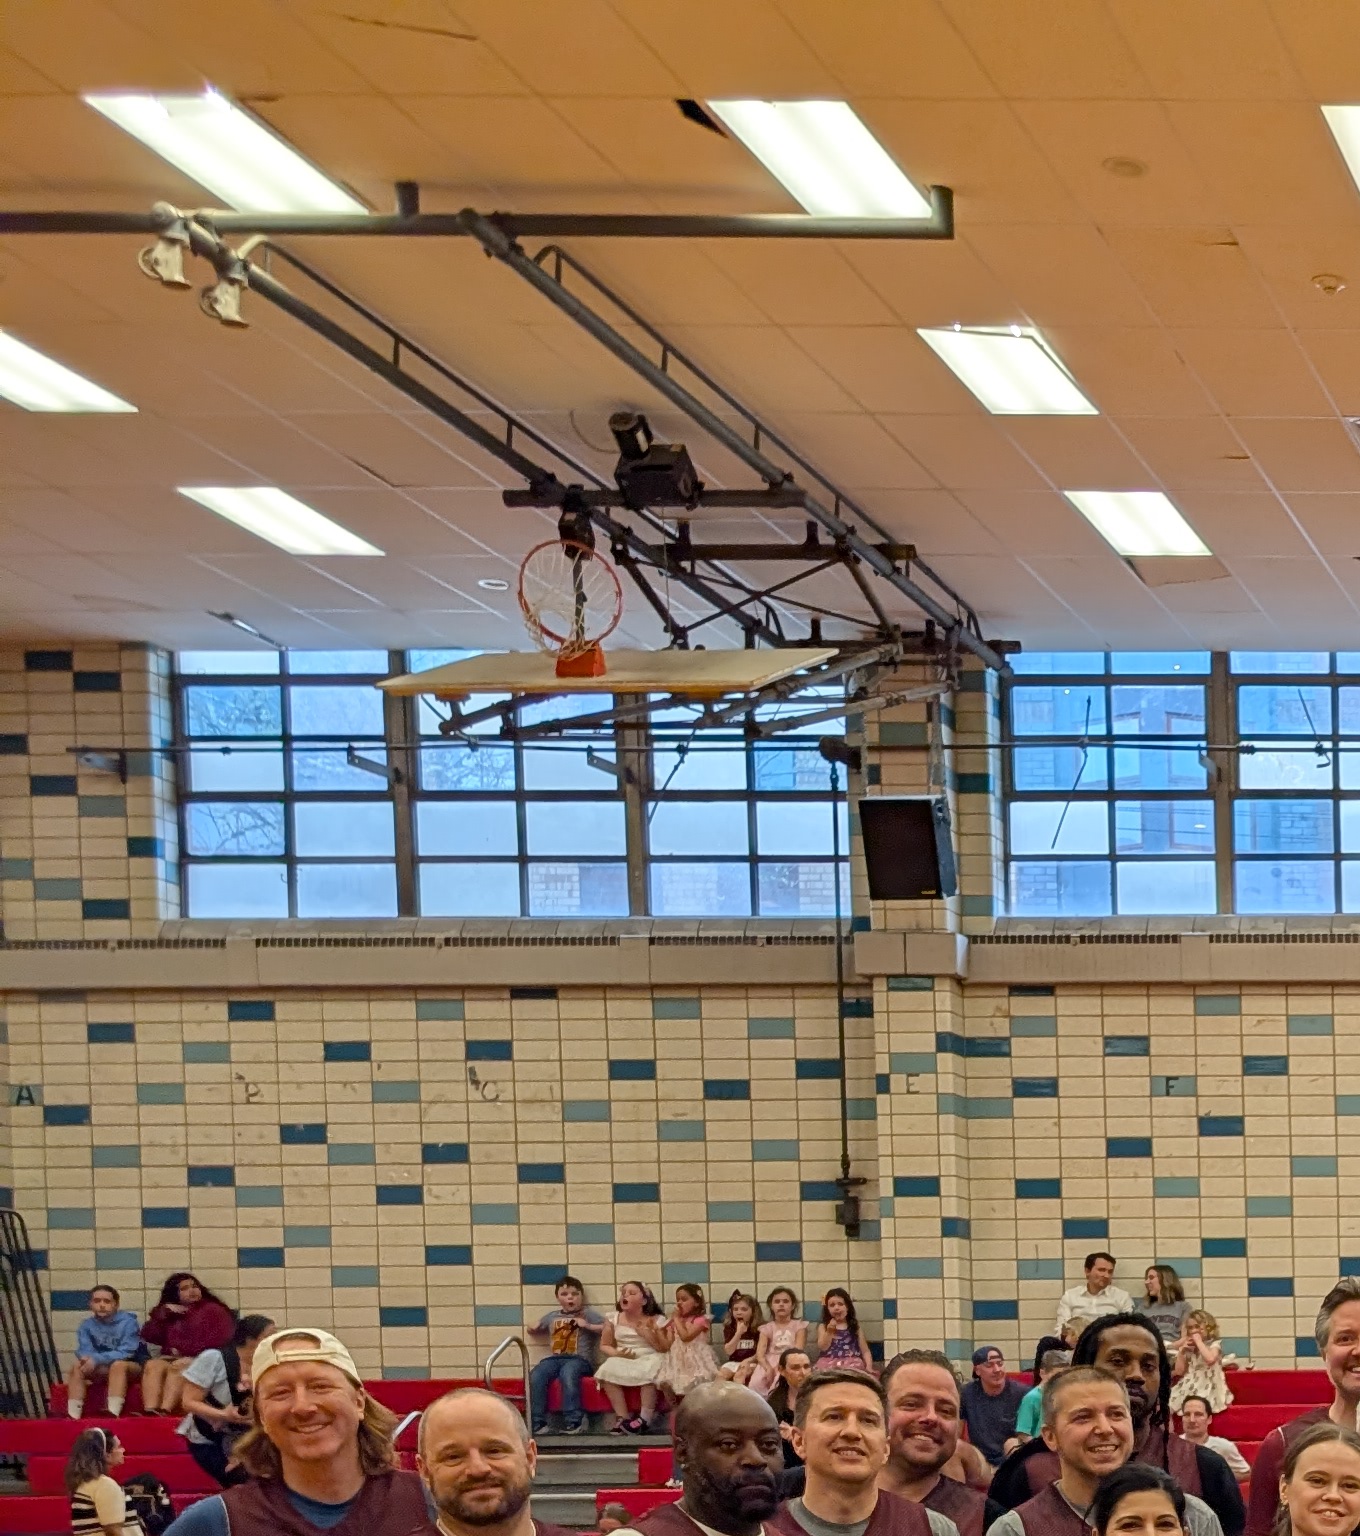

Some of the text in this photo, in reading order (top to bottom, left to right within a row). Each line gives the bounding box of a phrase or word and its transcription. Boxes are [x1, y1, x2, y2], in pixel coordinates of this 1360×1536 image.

[906, 1073, 920, 1094] E
[1165, 1076, 1180, 1096] F
[16, 1085, 35, 1106] A
